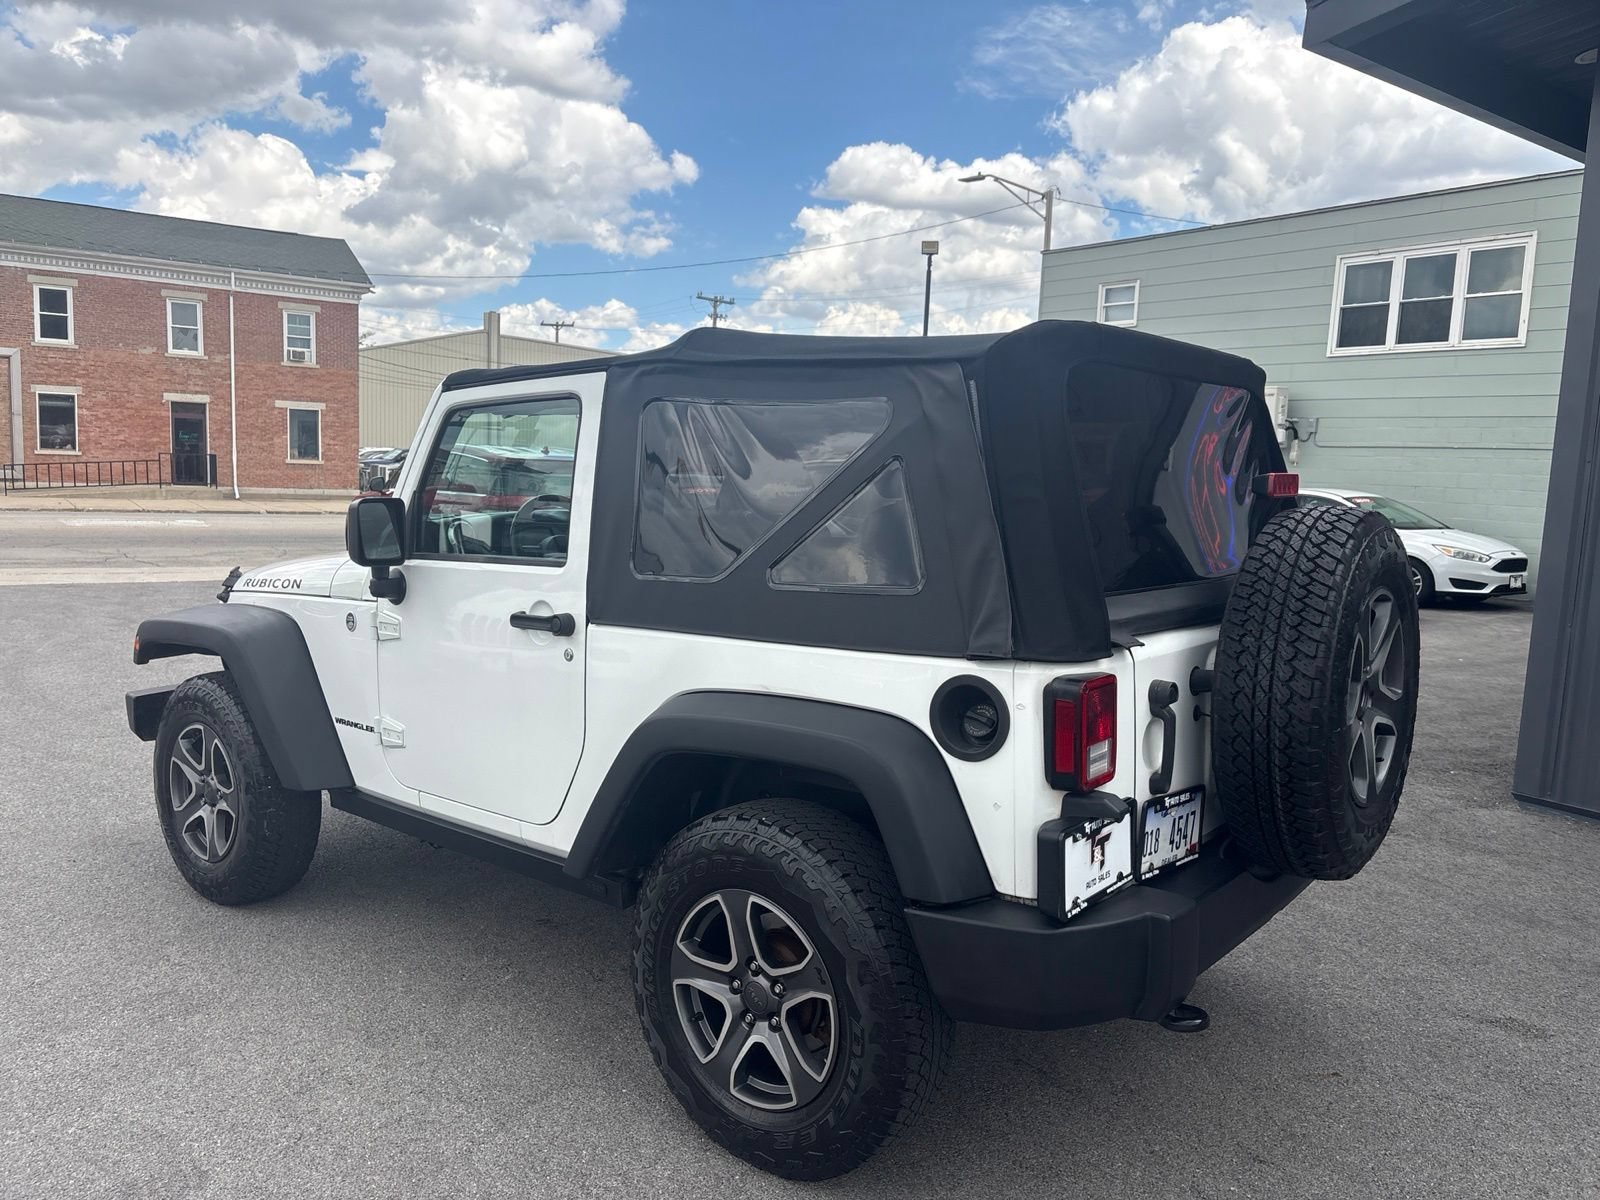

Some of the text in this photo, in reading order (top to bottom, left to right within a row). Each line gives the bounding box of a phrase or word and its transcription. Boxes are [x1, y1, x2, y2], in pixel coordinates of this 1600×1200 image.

[242, 578, 303, 589] RUBICON
[334, 716, 375, 733] WRANGLER
[1168, 809, 1197, 853] 4547
[1085, 877, 1097, 890] AUTO
[1097, 869, 1111, 883] SALES
[771, 1014, 866, 1151] DUELER
